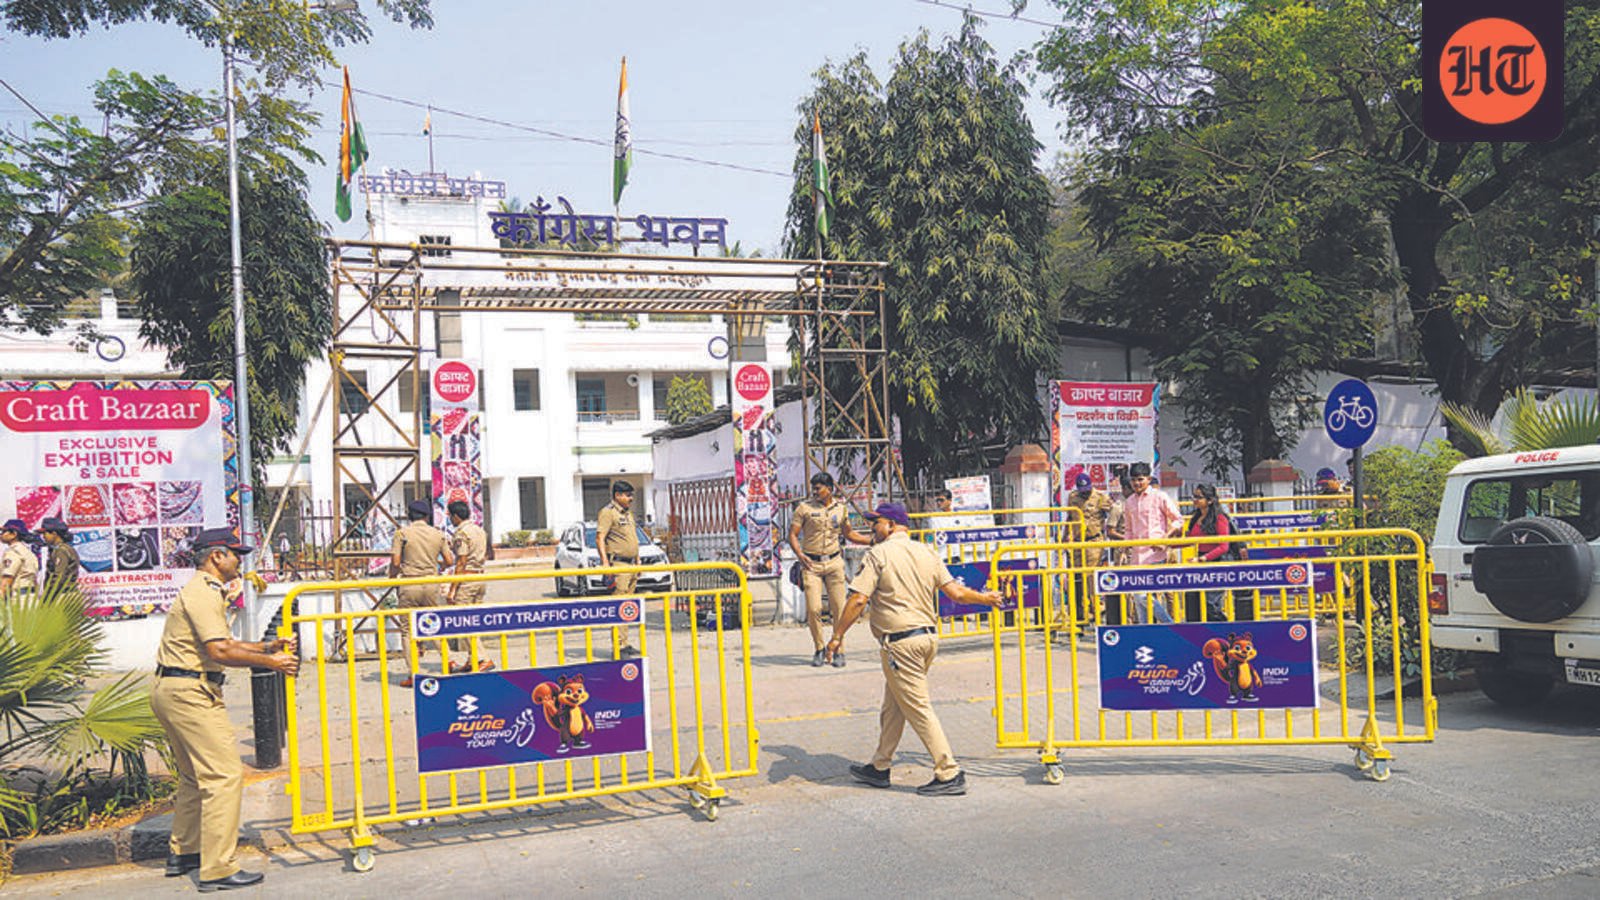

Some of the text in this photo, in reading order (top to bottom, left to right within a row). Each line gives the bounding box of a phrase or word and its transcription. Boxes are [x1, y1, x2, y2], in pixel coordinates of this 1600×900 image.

[487, 196, 728, 248] काँग्रेस भवन
[740, 371, 765, 382] Craft
[737, 381, 769, 391] Bazaar
[1108, 388, 1143, 403] बाजार
[6, 395, 201, 423] Craft Bazaar
[59, 436, 158, 450] EXCLUSIVE
[44, 451, 173, 467] EXHIBITION
[1514, 451, 1559, 464] POLICE
[80, 466, 140, 479] & SALE
[109, 573, 172, 584] ATTRACTION
[1121, 569, 1283, 587] PUNE CITY TRAFFIC POLICE
[443, 606, 616, 628] PUNE CITY TRAFFIC POLICE
[1263, 667, 1289, 676] INDU
[1150, 679, 1184, 687] GRAND
[1143, 686, 1170, 695] TOUR
[594, 709, 621, 720] INDU
[472, 729, 512, 740] GRAND
[466, 739, 496, 749] TOUR
